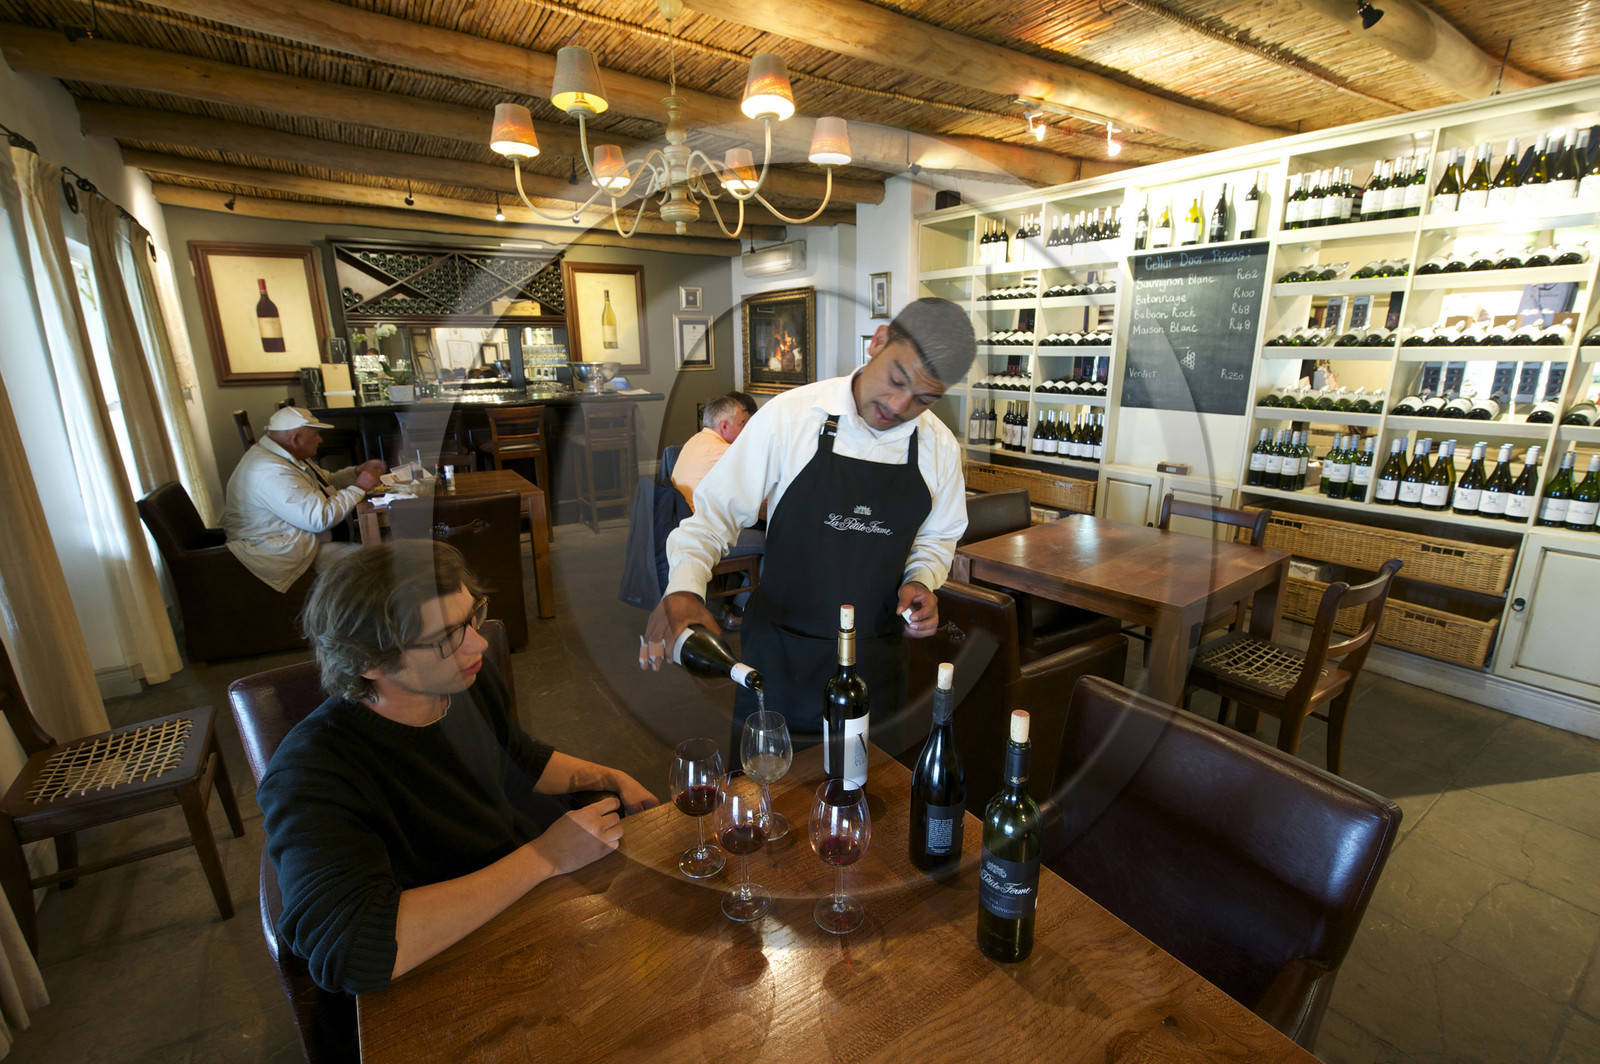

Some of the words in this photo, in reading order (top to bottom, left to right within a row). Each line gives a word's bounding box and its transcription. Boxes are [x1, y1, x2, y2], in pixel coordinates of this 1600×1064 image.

[1145, 255, 1173, 271] Cellar
[1180, 252, 1203, 267] Door
[1212, 249, 1251, 263] Prices:
[1135, 277, 1184, 292] Sauvignon
[1188, 273, 1215, 286] Blanc
[1236, 268, 1258, 281] R62
[1135, 293, 1187, 306] Batonnage
[1233, 287, 1255, 298] R100
[1133, 308, 1168, 320] Baboon
[1172, 306, 1197, 319] Rock
[1231, 302, 1250, 315] R68
[1132, 324, 1165, 336] Maison
[1170, 321, 1199, 333] Blanc
[1229, 317, 1251, 331] R48
[1220, 368, 1244, 381] R250
[824, 513, 847, 531] La
[840, 517, 867, 531] Petite
[866, 521, 893, 536] Ferme
[1000, 882, 1033, 895] Ferme
